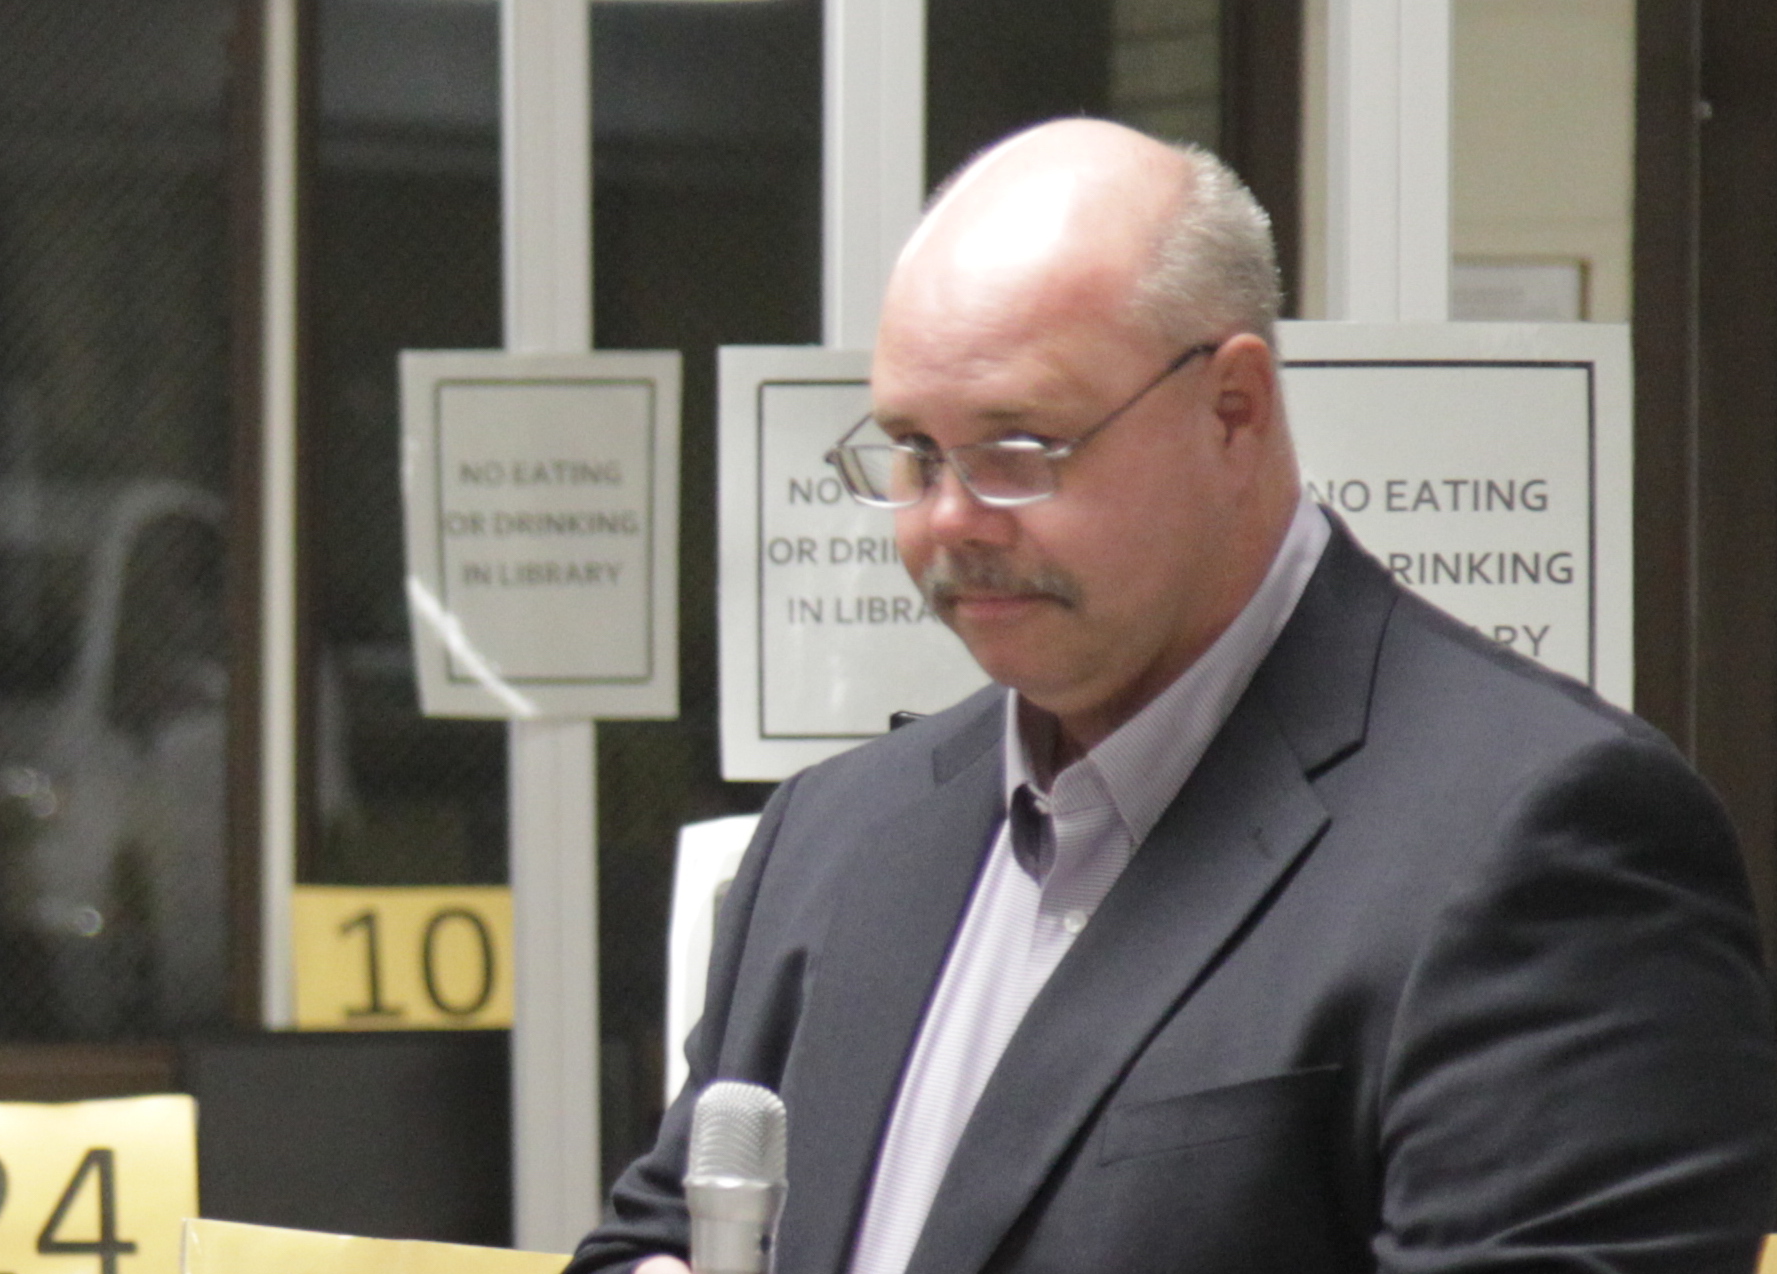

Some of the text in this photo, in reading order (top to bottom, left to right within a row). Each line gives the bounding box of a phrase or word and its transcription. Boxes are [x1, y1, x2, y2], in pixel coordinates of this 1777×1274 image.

[788, 476, 843, 505] NO
[1384, 478, 1549, 513] EATING
[767, 536, 818, 566] OR
[1388, 551, 1574, 585] RINKING
[787, 596, 938, 625] IN LIBRA
[336, 905, 497, 1025] 10
